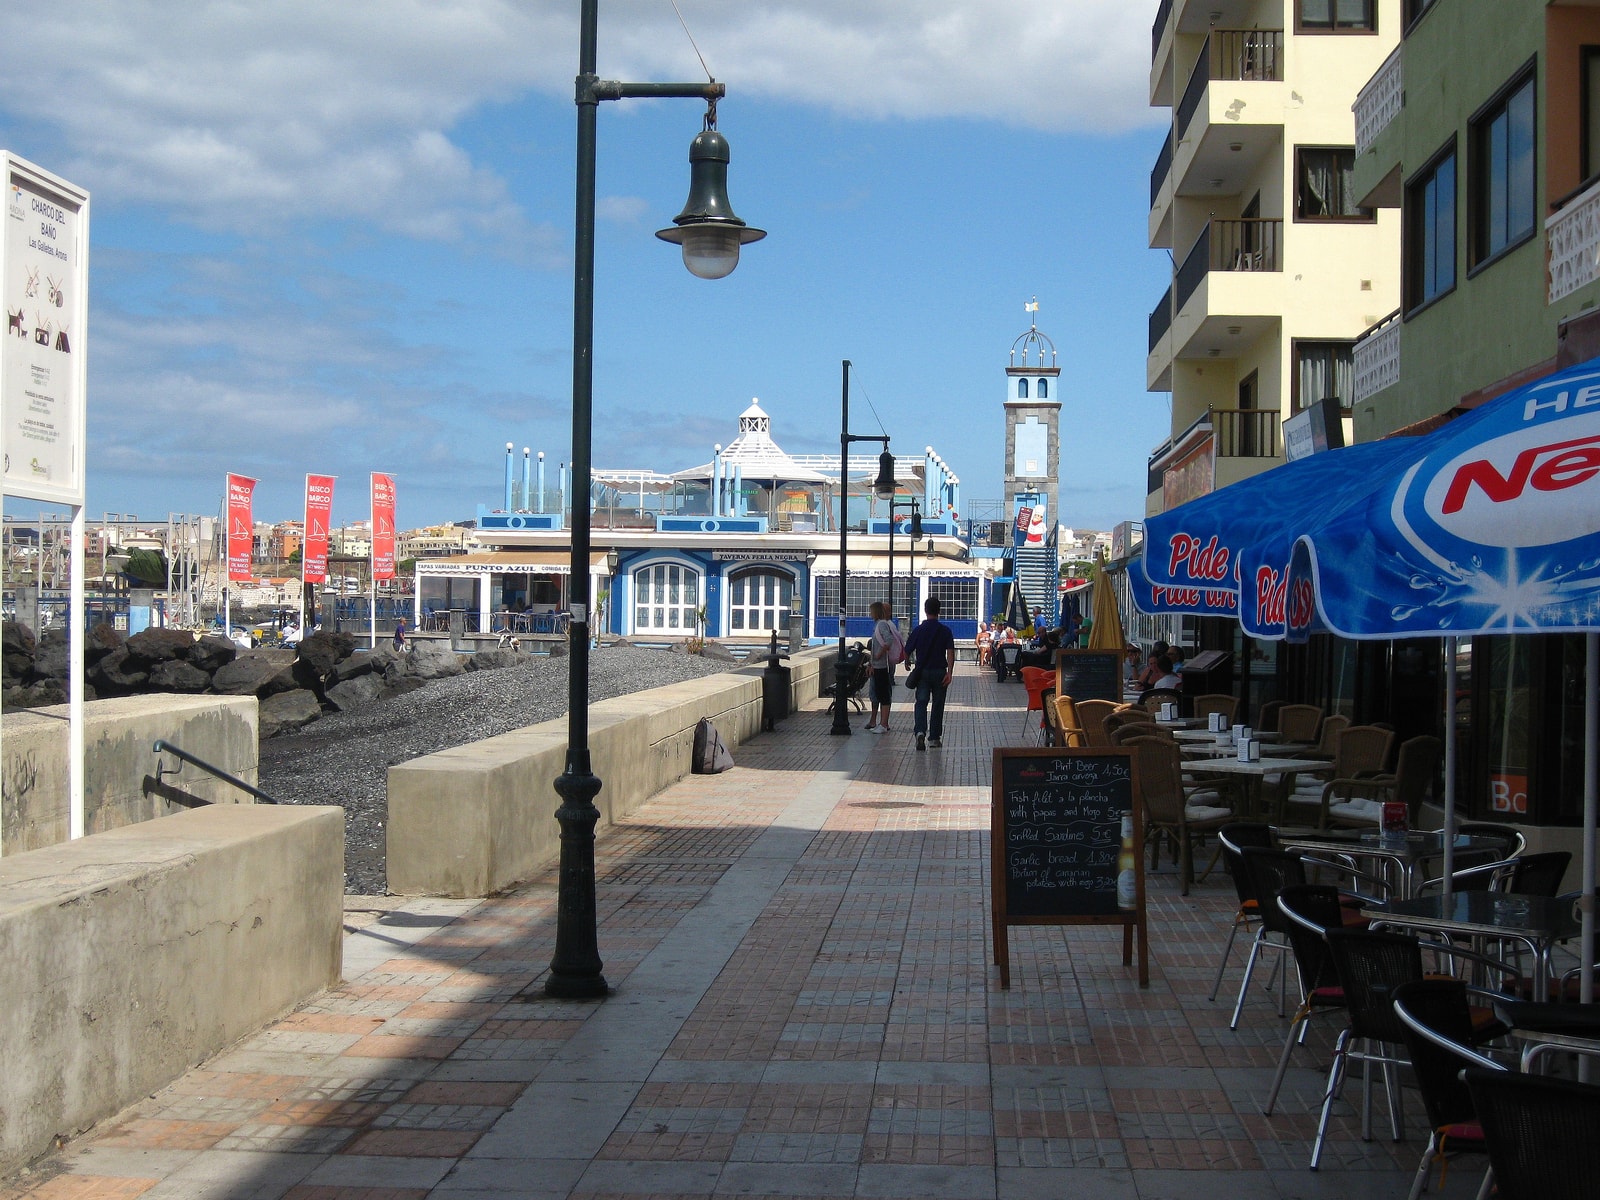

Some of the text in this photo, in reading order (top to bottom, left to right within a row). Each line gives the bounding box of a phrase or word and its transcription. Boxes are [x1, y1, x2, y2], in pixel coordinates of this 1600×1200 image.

[31, 198, 54, 220] CHARCO
[55, 210, 66, 225] DEL
[41, 222, 57, 240] BAÑO
[28, 235, 37, 249] Las
[309, 485, 331, 494] BUSCO
[308, 494, 331, 503] BARCO
[1169, 533, 1229, 581] Pide
[1256, 564, 1288, 625] Pid
[1052, 759, 1073, 771] Pint
[1076, 760, 1099, 772] Beer
[1008, 790, 1029, 803] Fish
[1068, 791, 1076, 802] la
[1009, 805, 1028, 819] with
[1033, 806, 1057, 821] papas
[1063, 807, 1078, 816] and
[1008, 827, 1039, 842] Grilled
[1044, 827, 1085, 842] Sardines
[1010, 852, 1041, 867] Garlic
[1048, 850, 1078, 864] bread
[1011, 867, 1090, 880] Portion of canarian
[1058, 876, 1077, 888] with
